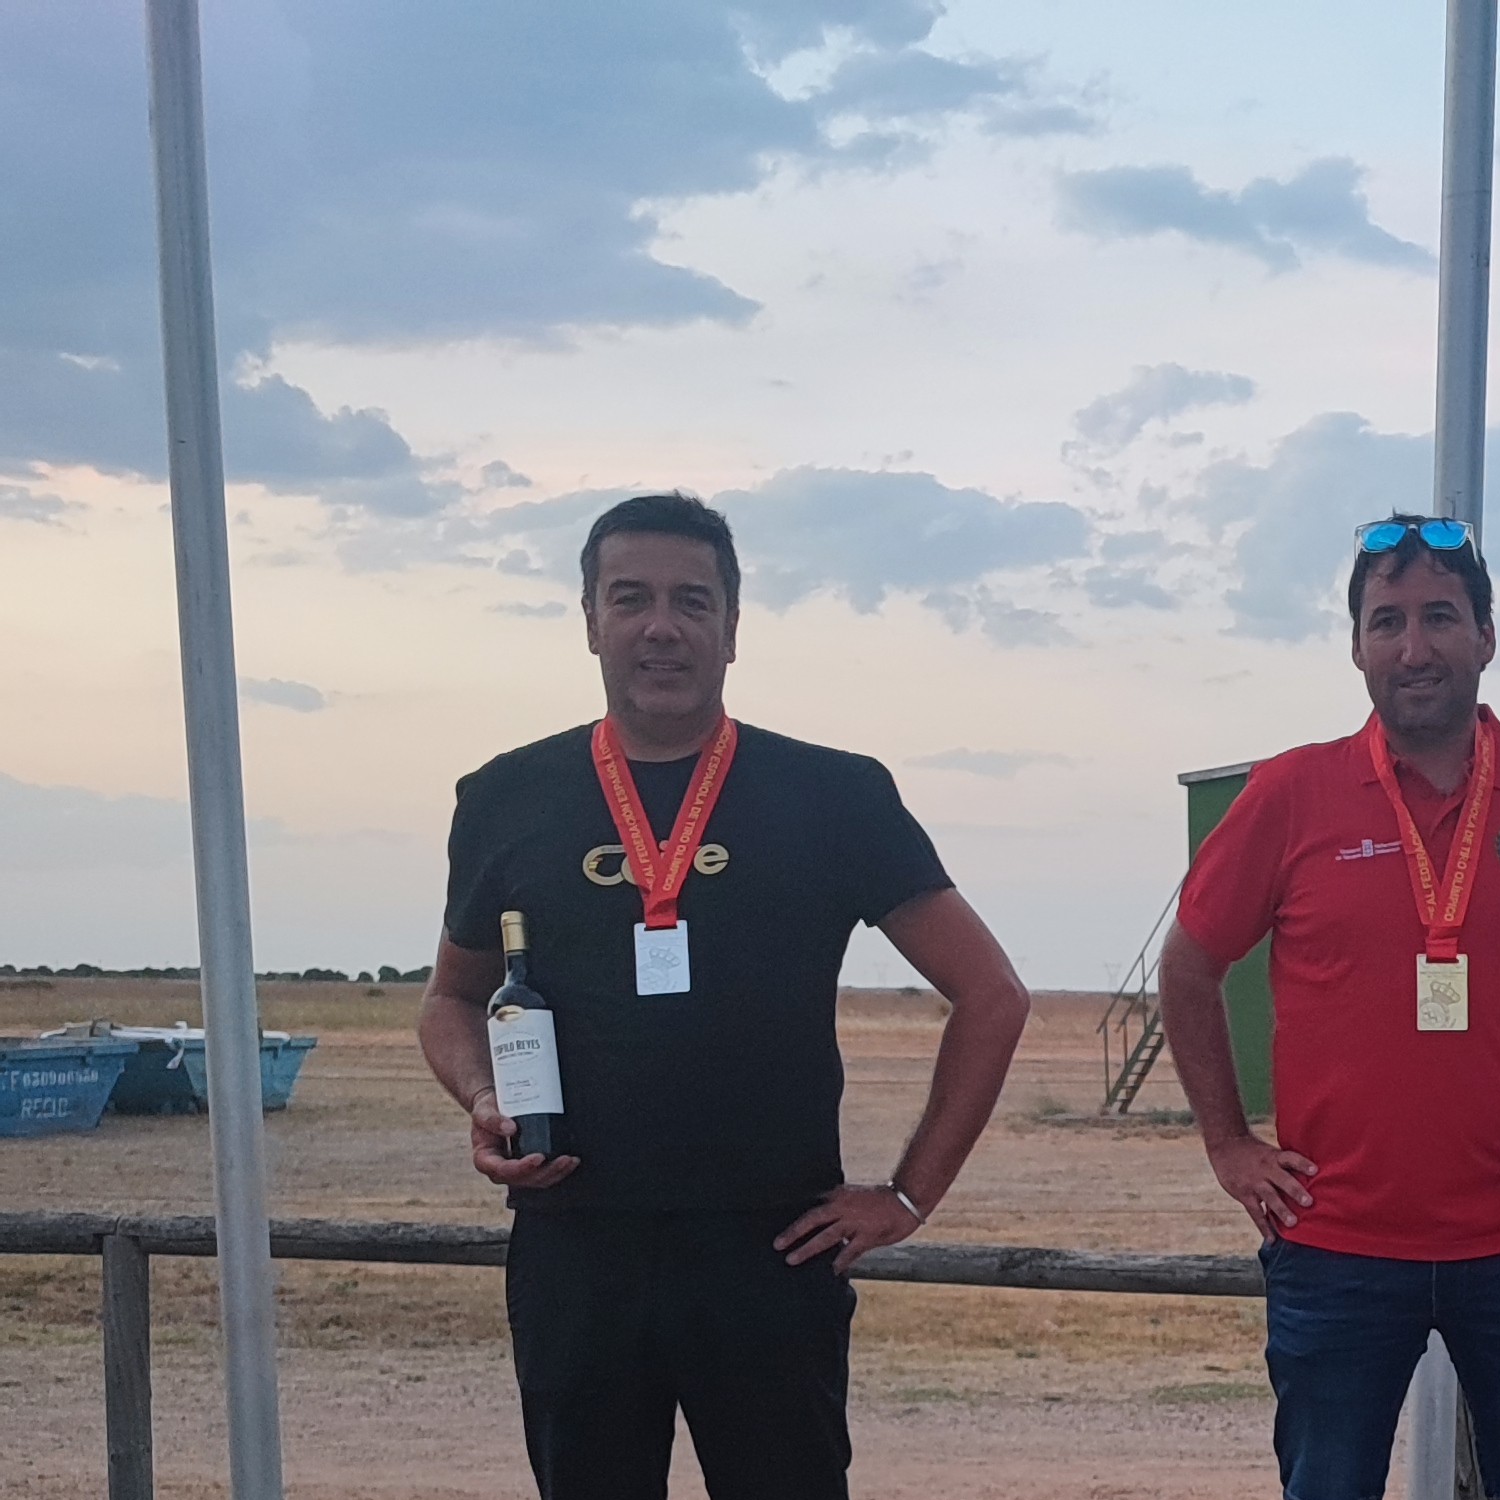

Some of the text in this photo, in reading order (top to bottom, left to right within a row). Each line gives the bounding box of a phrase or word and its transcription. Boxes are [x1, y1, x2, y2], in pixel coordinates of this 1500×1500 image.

[696, 755, 721, 807] ESPAÑOLA
[688, 806, 702, 821] DE
[680, 821, 696, 844] TIRO
[1462, 829, 1474, 844] DE
[662, 844, 687, 892] OLÍMPICO
[1457, 845, 1471, 869] TIRO
[1444, 870, 1465, 922] OLÍMPICO
